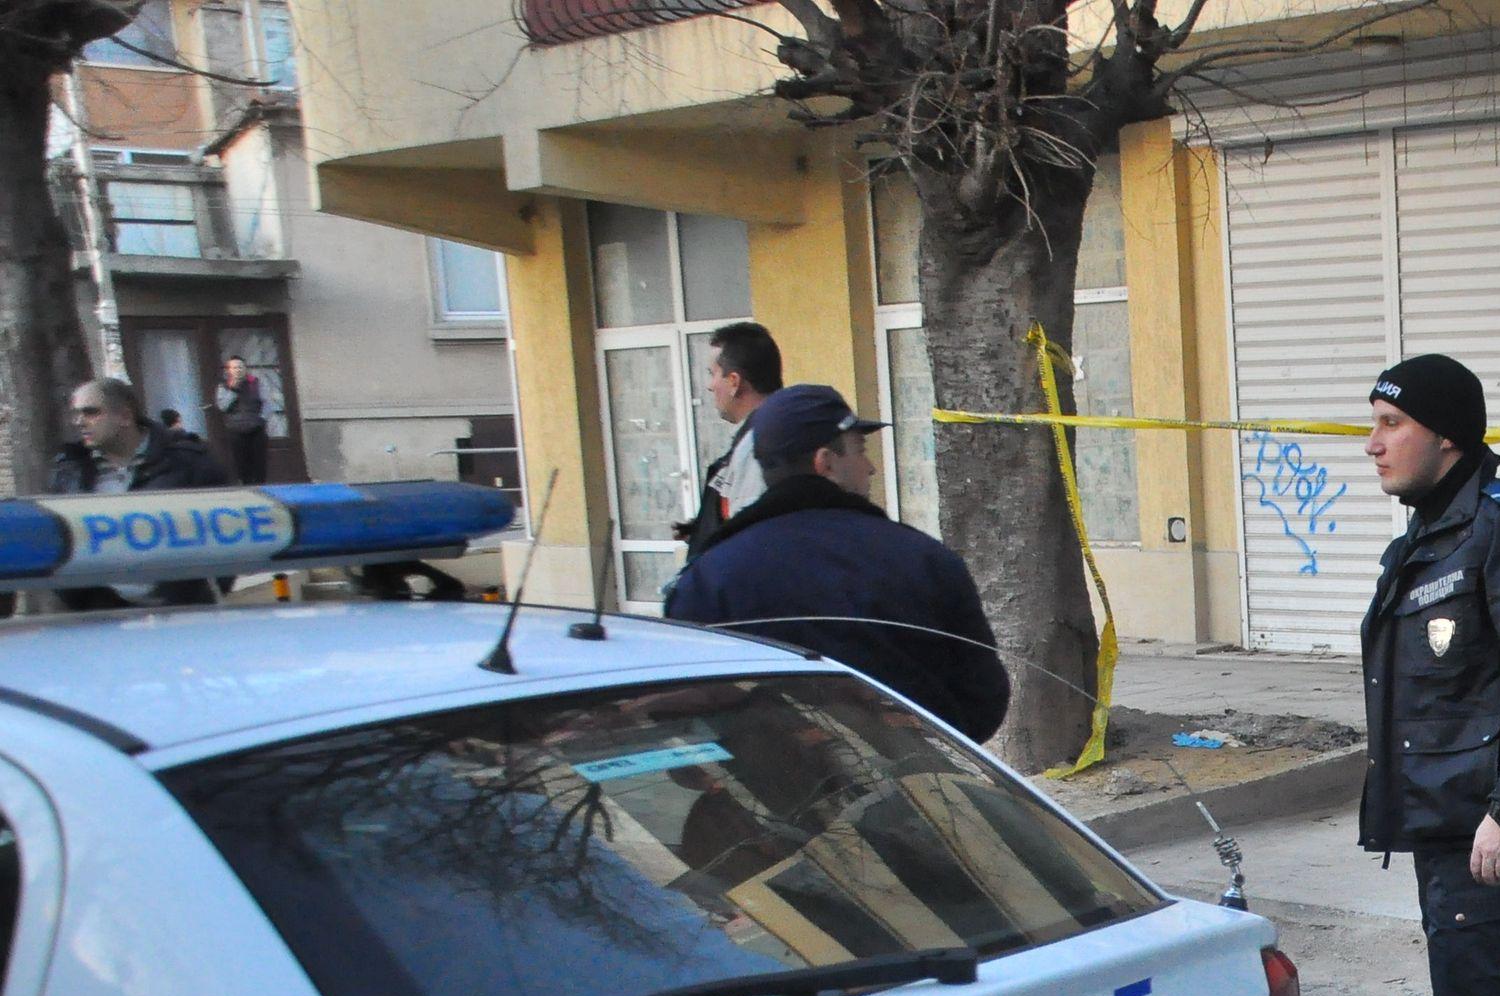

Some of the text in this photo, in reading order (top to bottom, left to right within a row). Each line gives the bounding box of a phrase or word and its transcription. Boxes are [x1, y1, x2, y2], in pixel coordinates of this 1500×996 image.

[82, 505, 277, 554] POLICE
[1410, 569, 1464, 600] ОХРАНИТЕЛНА
[1418, 582, 1454, 607] ПОЛИЦИЯ
